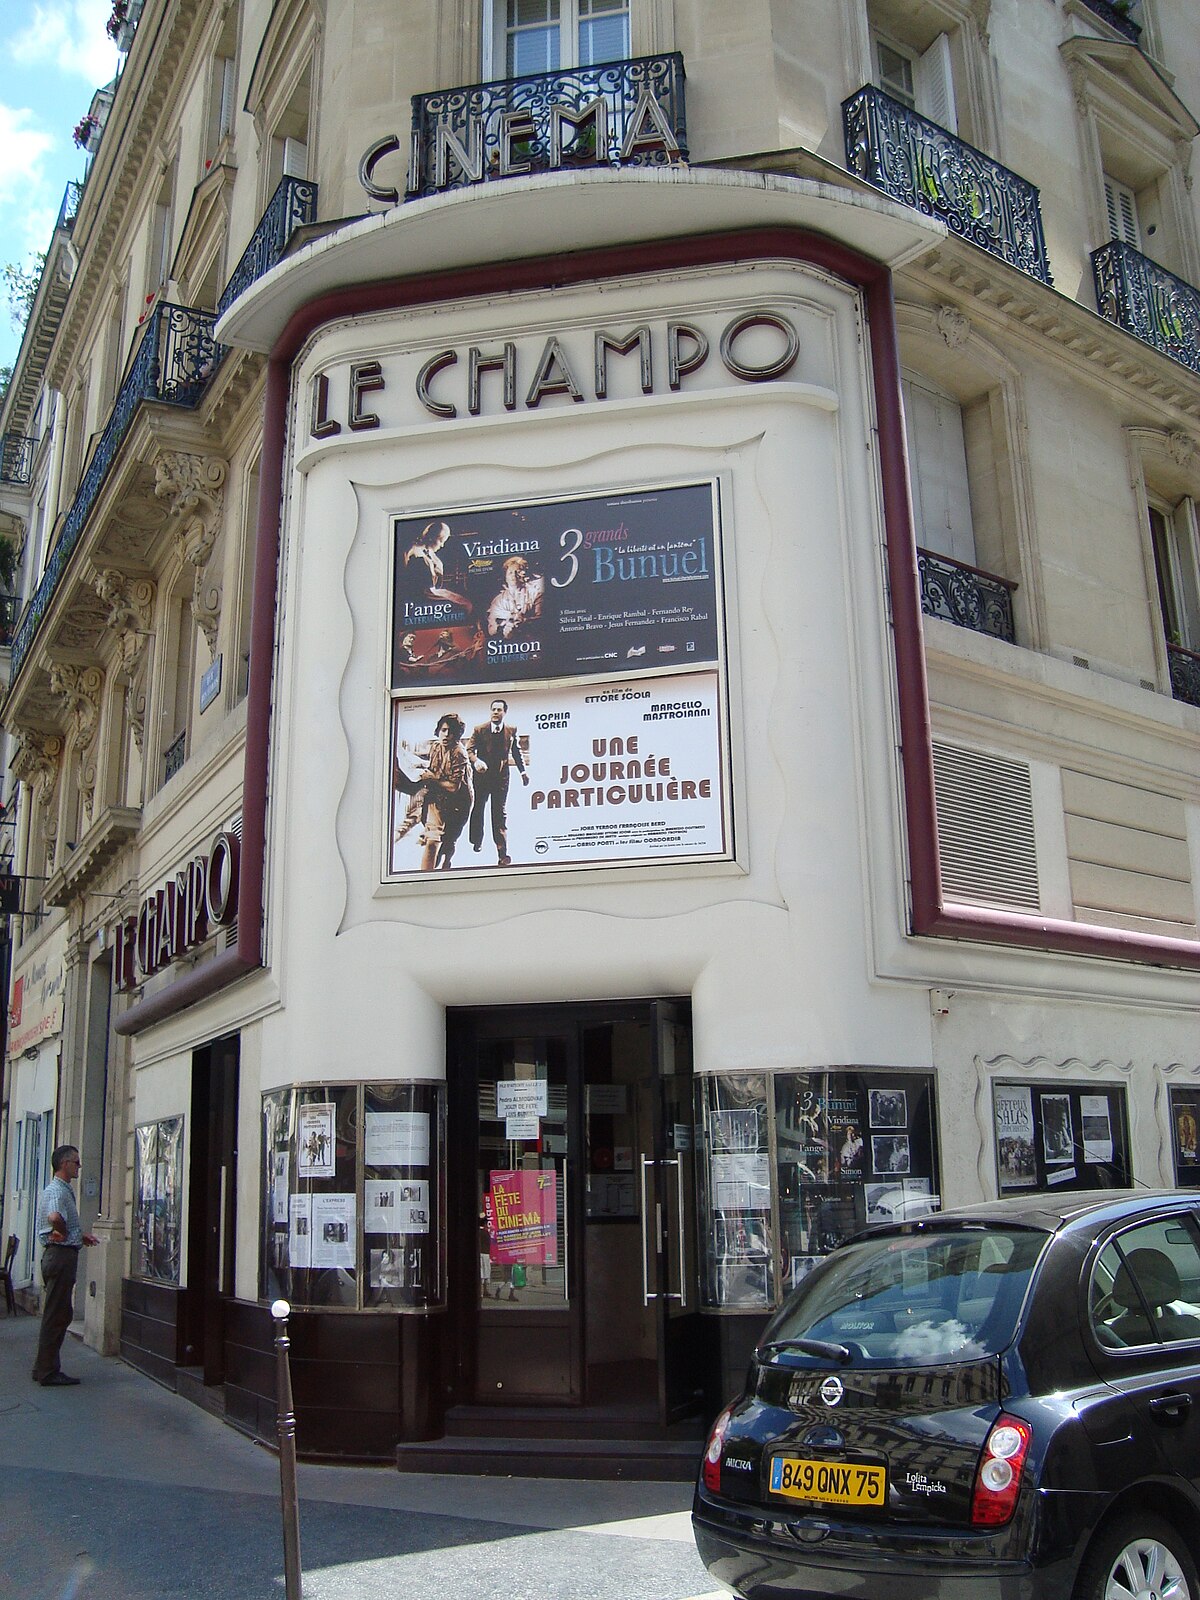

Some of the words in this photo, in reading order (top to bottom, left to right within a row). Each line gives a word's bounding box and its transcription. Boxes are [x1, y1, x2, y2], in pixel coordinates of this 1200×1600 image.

[359, 88, 681, 203] CINEMA
[309, 360, 385, 442] LE
[416, 310, 799, 419] CHAMPO
[583, 522, 629, 550] grands
[462, 538, 541, 559] Viridiana
[551, 528, 583, 588] 3
[592, 537, 709, 584] Bunuel
[559, 616, 577, 624] Silvia
[579, 614, 593, 622] Pinal
[598, 612, 622, 621] Enrique
[652, 607, 680, 617] Fernando
[682, 605, 694, 615] Rey
[559, 624, 584, 633] Antonio
[586, 622, 603, 630] Bravo
[608, 621, 624, 630] Jesus
[625, 618, 655, 627] Fernandez
[661, 615, 689, 624] Francisco
[691, 612, 708, 621] Rabal
[486, 639, 541, 656] Simon
[585, 694, 619, 703] ETTORE
[622, 691, 651, 701] SCOLA
[651, 700, 702, 712] MARCELLO
[535, 712, 571, 722] SOPHIA
[643, 708, 710, 721] MASTROIANNI
[538, 720, 568, 730] LOREN
[592, 735, 639, 758] UNE
[560, 754, 671, 784] JOURNÉE
[531, 776, 711, 810] PARTICULIÈRE
[800, 1091, 814, 1112] 3
[827, 1114, 859, 1124] Viridiana
[840, 1166, 862, 1175] Simon
[493, 1184, 505, 1195] LA
[496, 1206, 509, 1217] DU
[498, 1211, 542, 1230] CINEMA
[725, 1457, 752, 1471] MICRA
[774, 1476, 779, 1485] F
[782, 1463, 815, 1491] 849
[817, 1466, 852, 1497] QNX
[856, 1470, 881, 1499] 75
[906, 1472, 928, 1484] Lolita
[911, 1480, 947, 1496] Lempicka
